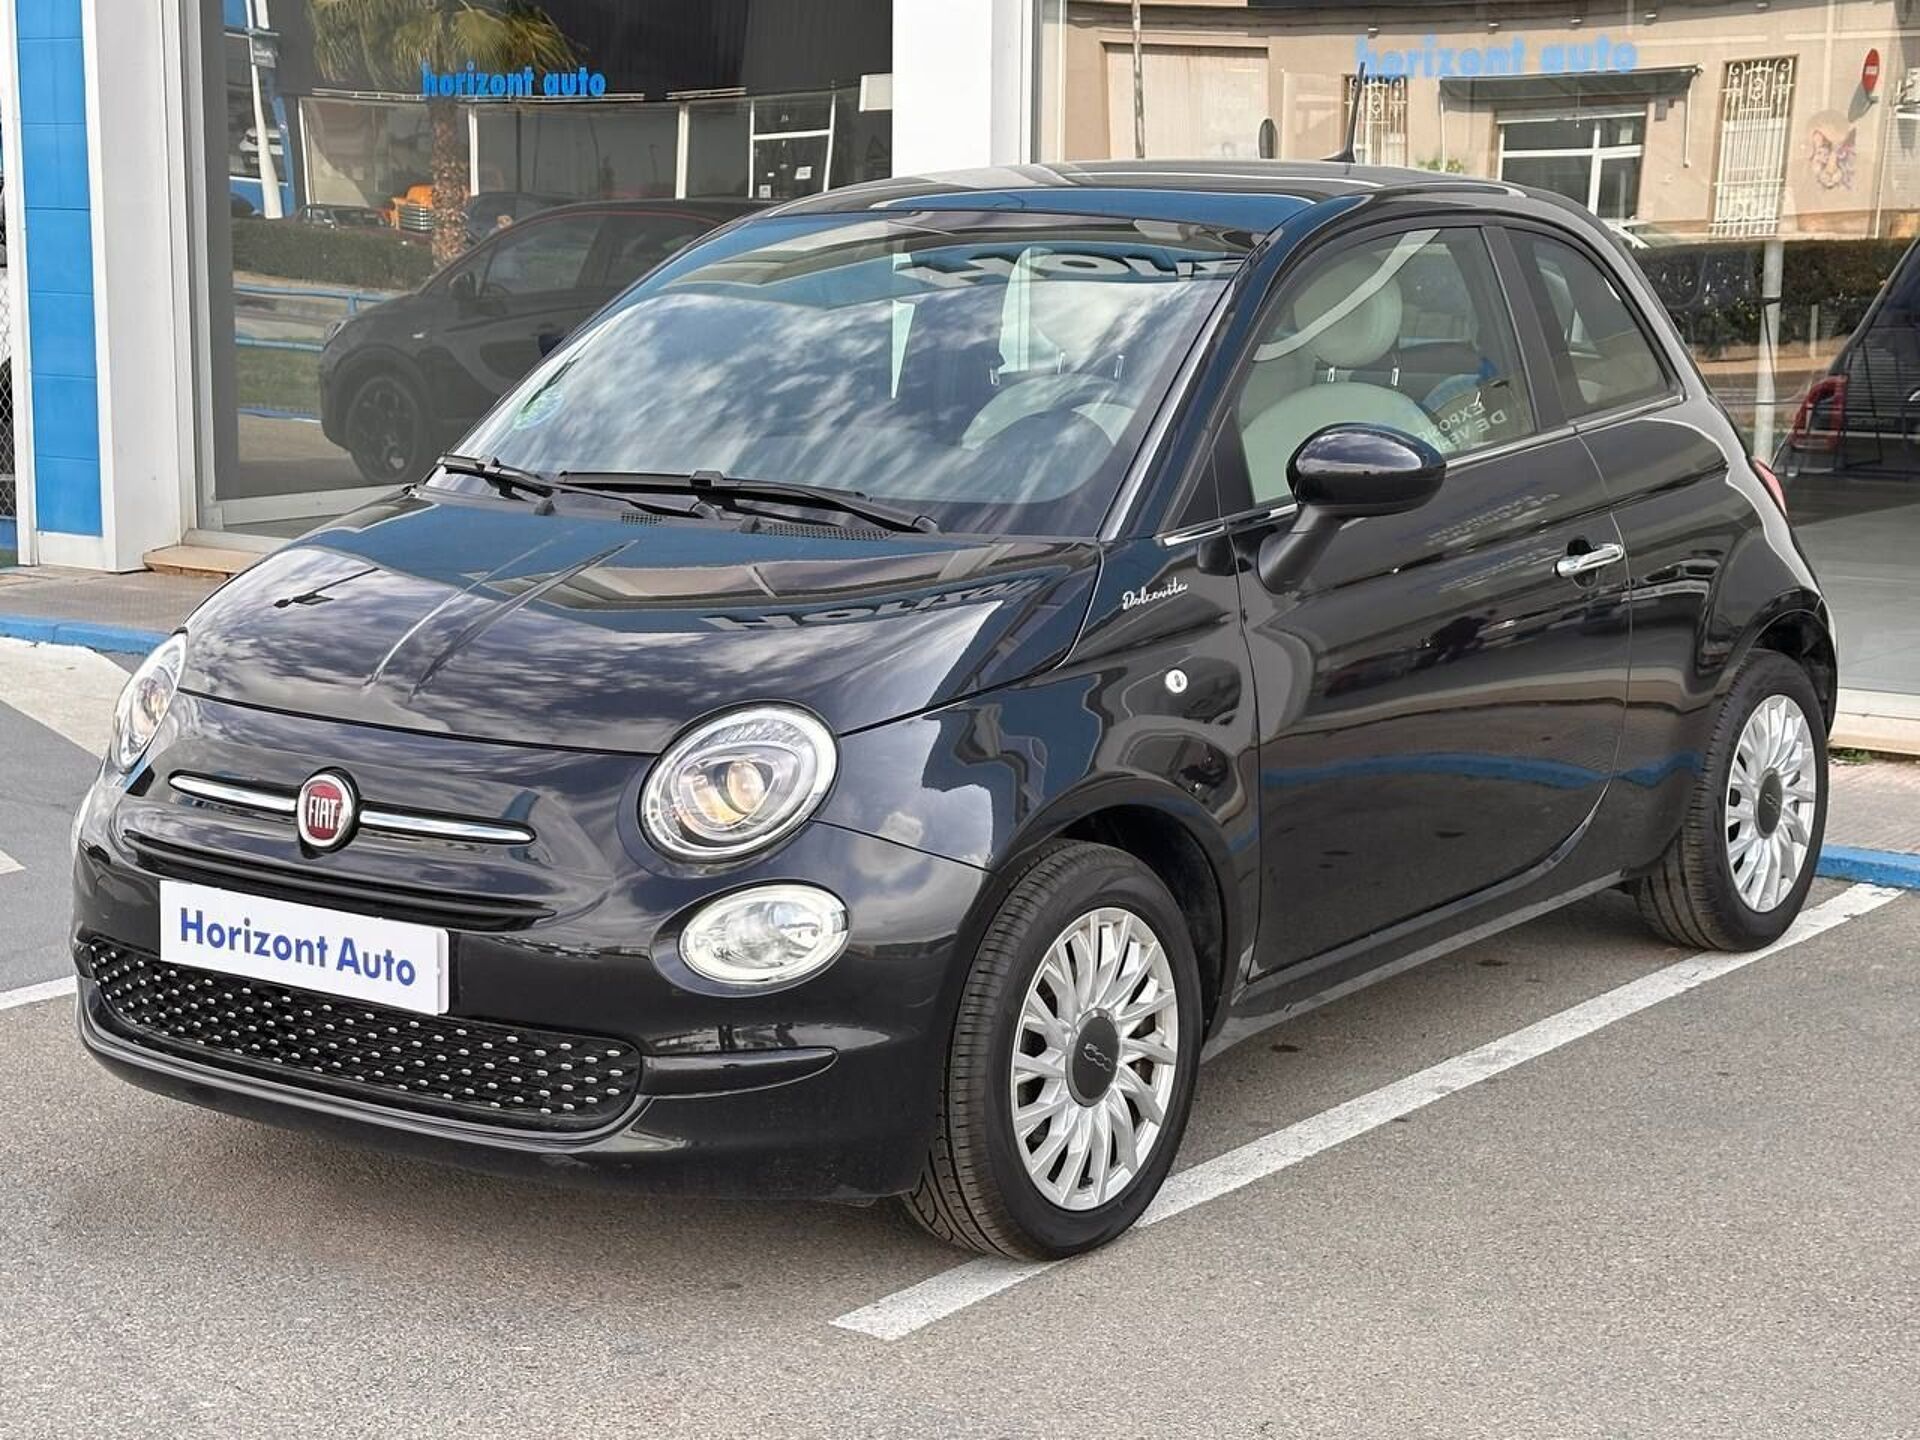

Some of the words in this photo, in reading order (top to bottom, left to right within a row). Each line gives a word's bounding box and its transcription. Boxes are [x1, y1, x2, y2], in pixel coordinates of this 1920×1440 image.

[1355, 33, 1525, 78] horizont
[1539, 34, 1638, 73] auto
[421, 60, 534, 97] horizont
[543, 67, 606, 97] auto
[308, 795, 339, 830] FIAT
[180, 907, 328, 968] Horizont
[337, 937, 416, 986] Auto
